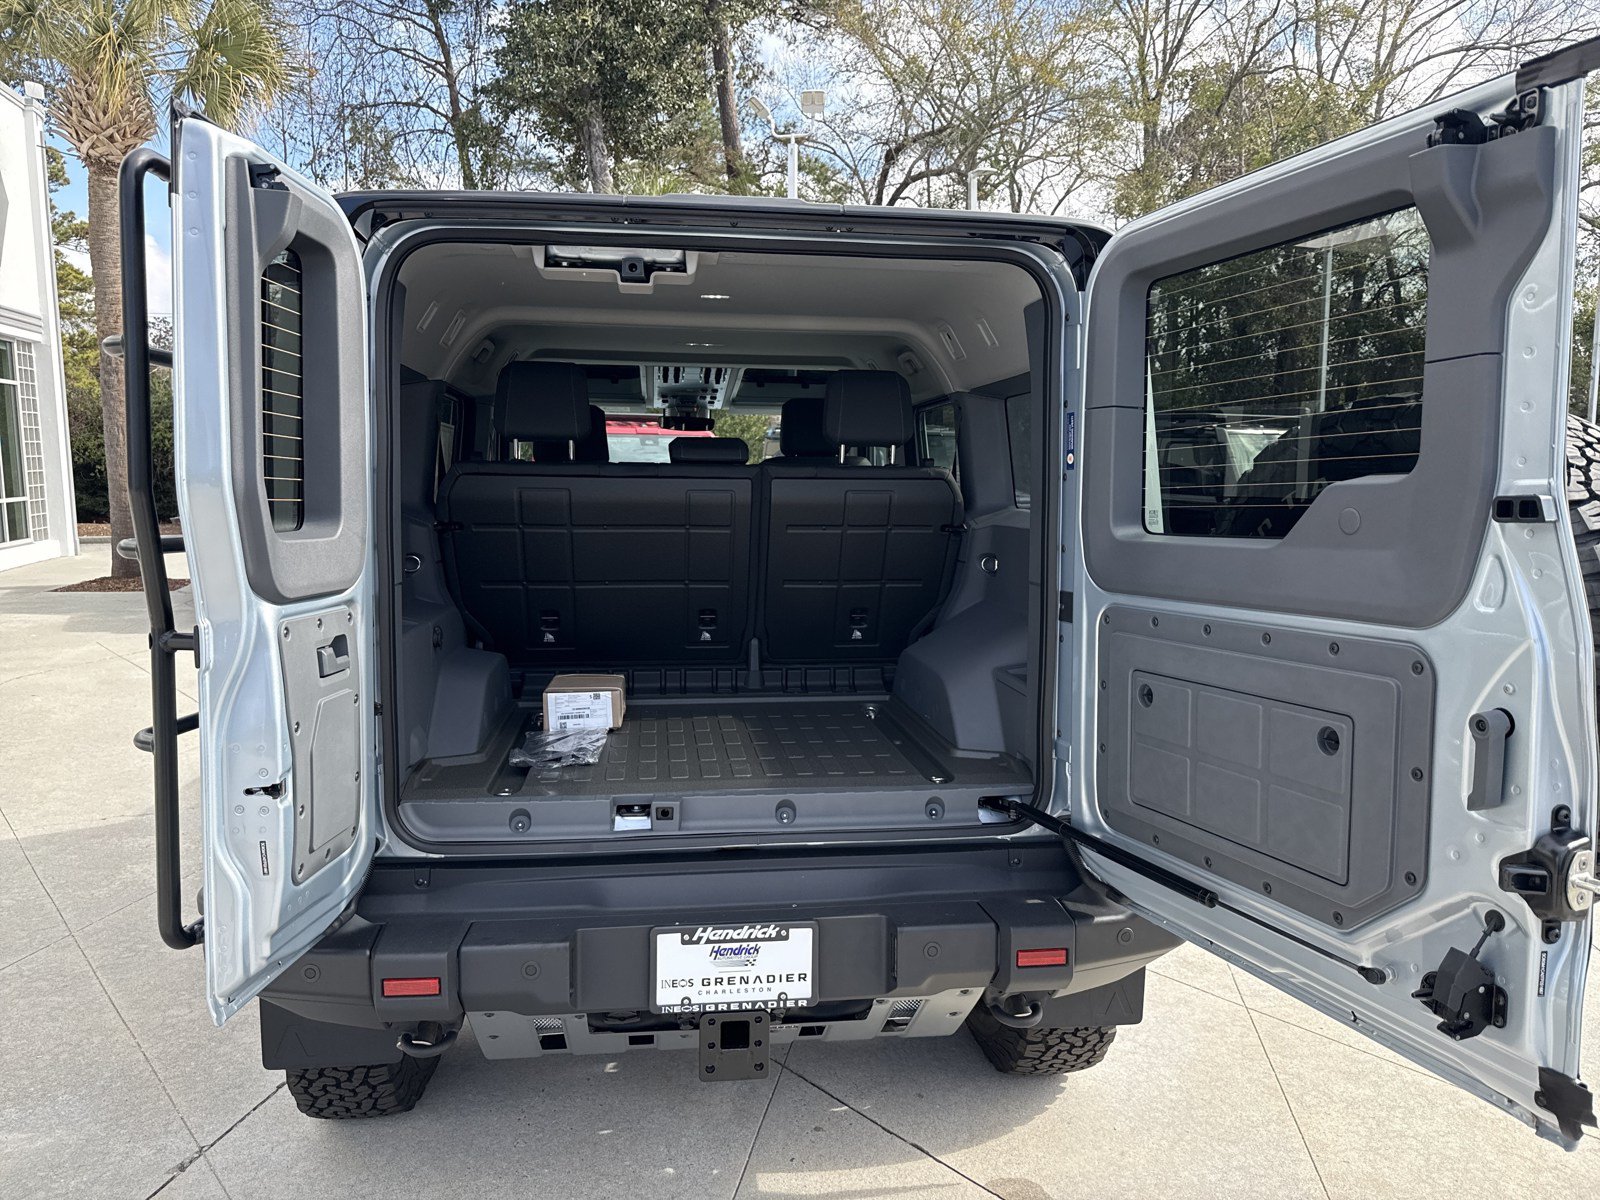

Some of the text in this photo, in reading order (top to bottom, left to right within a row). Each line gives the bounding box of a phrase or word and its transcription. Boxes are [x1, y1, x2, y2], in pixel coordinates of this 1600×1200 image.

[692, 924, 780, 944] Hendrick
[709, 943, 762, 960] Hendrick
[661, 973, 808, 989] INEOS GRENADIER
[697, 987, 772, 996] CHARLESTON
[661, 1000, 808, 1014] INEOS GRENADIER
